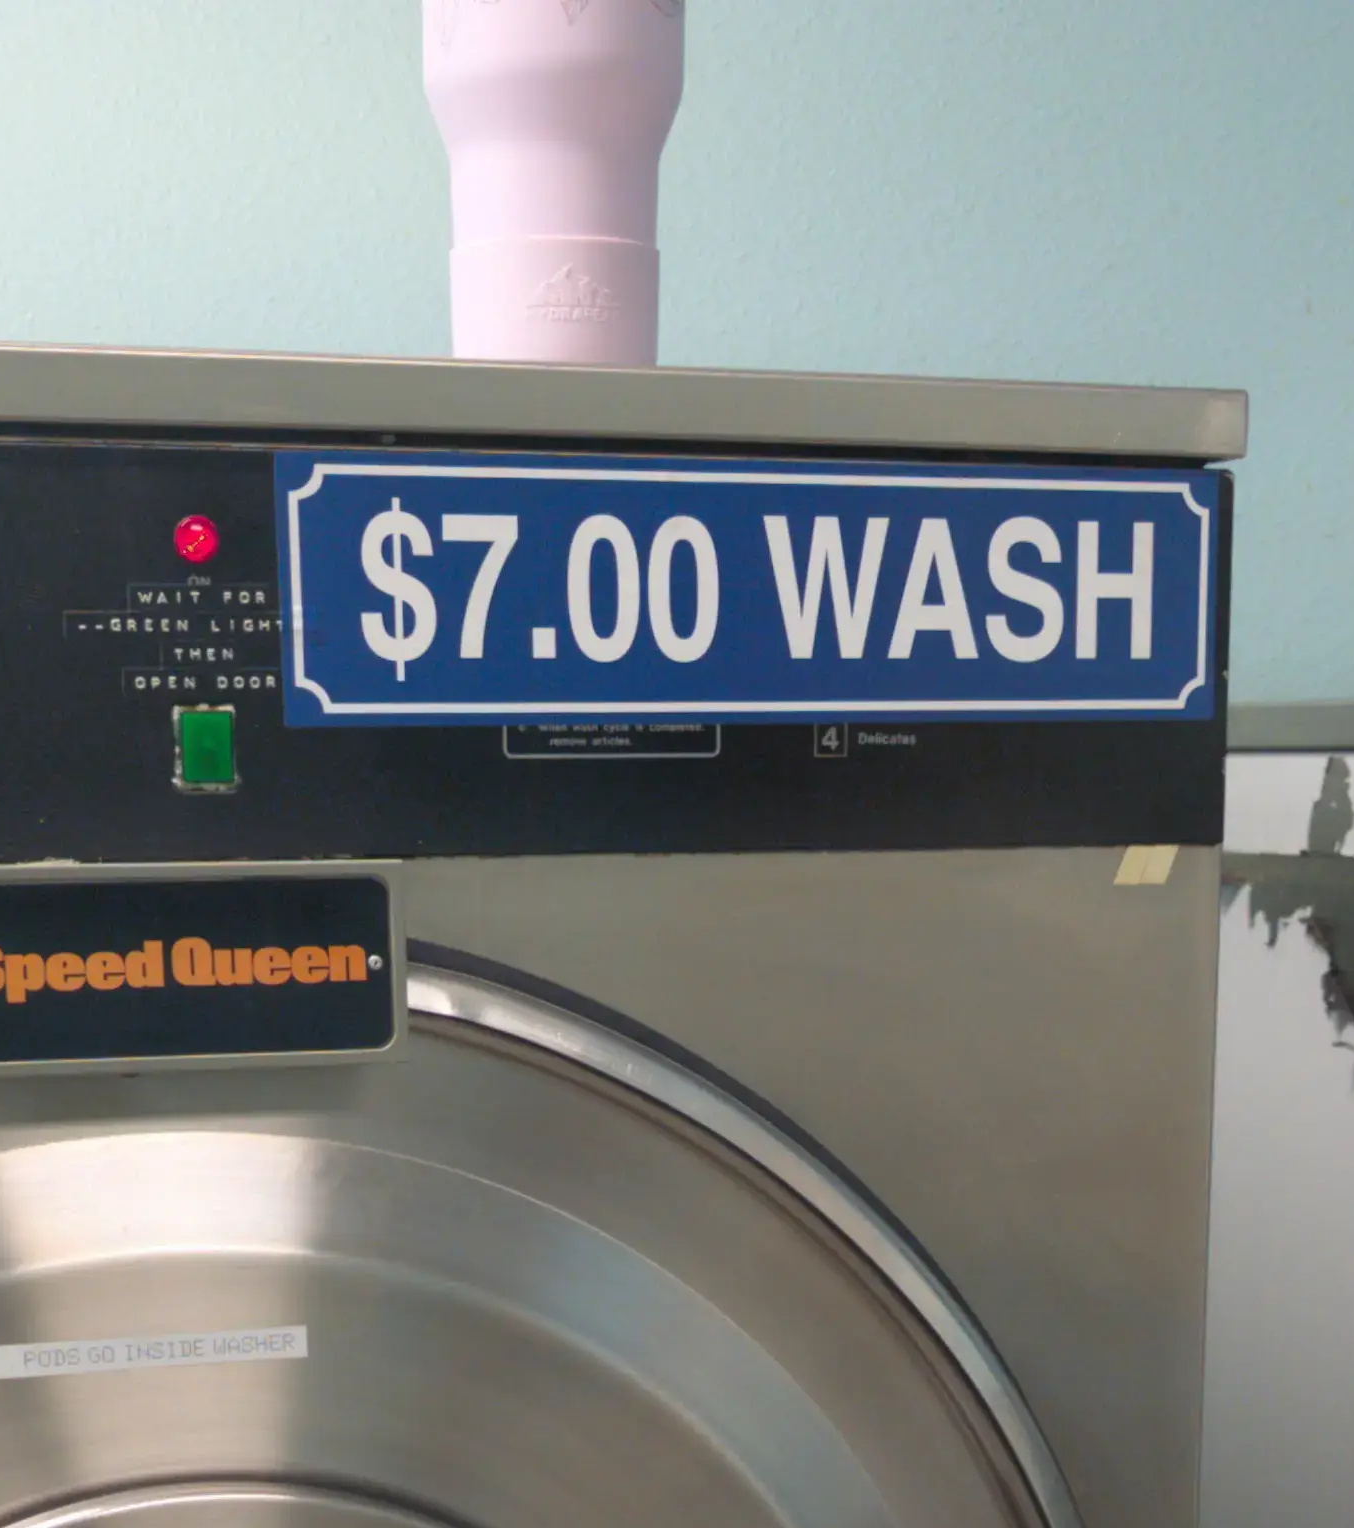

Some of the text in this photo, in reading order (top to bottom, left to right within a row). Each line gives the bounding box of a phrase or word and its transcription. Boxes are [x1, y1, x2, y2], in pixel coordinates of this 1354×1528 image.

[137, 591, 266, 604] WAIT FOR
[360, 497, 1155, 682] $7.00 WASH
[174, 647, 234, 662] THEN
[134, 676, 276, 690] OPEN DOOR
[821, 726, 917, 751] 4 Delicates
[171, 936, 368, 988] Queen
[23, 1332, 296, 1371] PODS GO INSIDE WASHER
